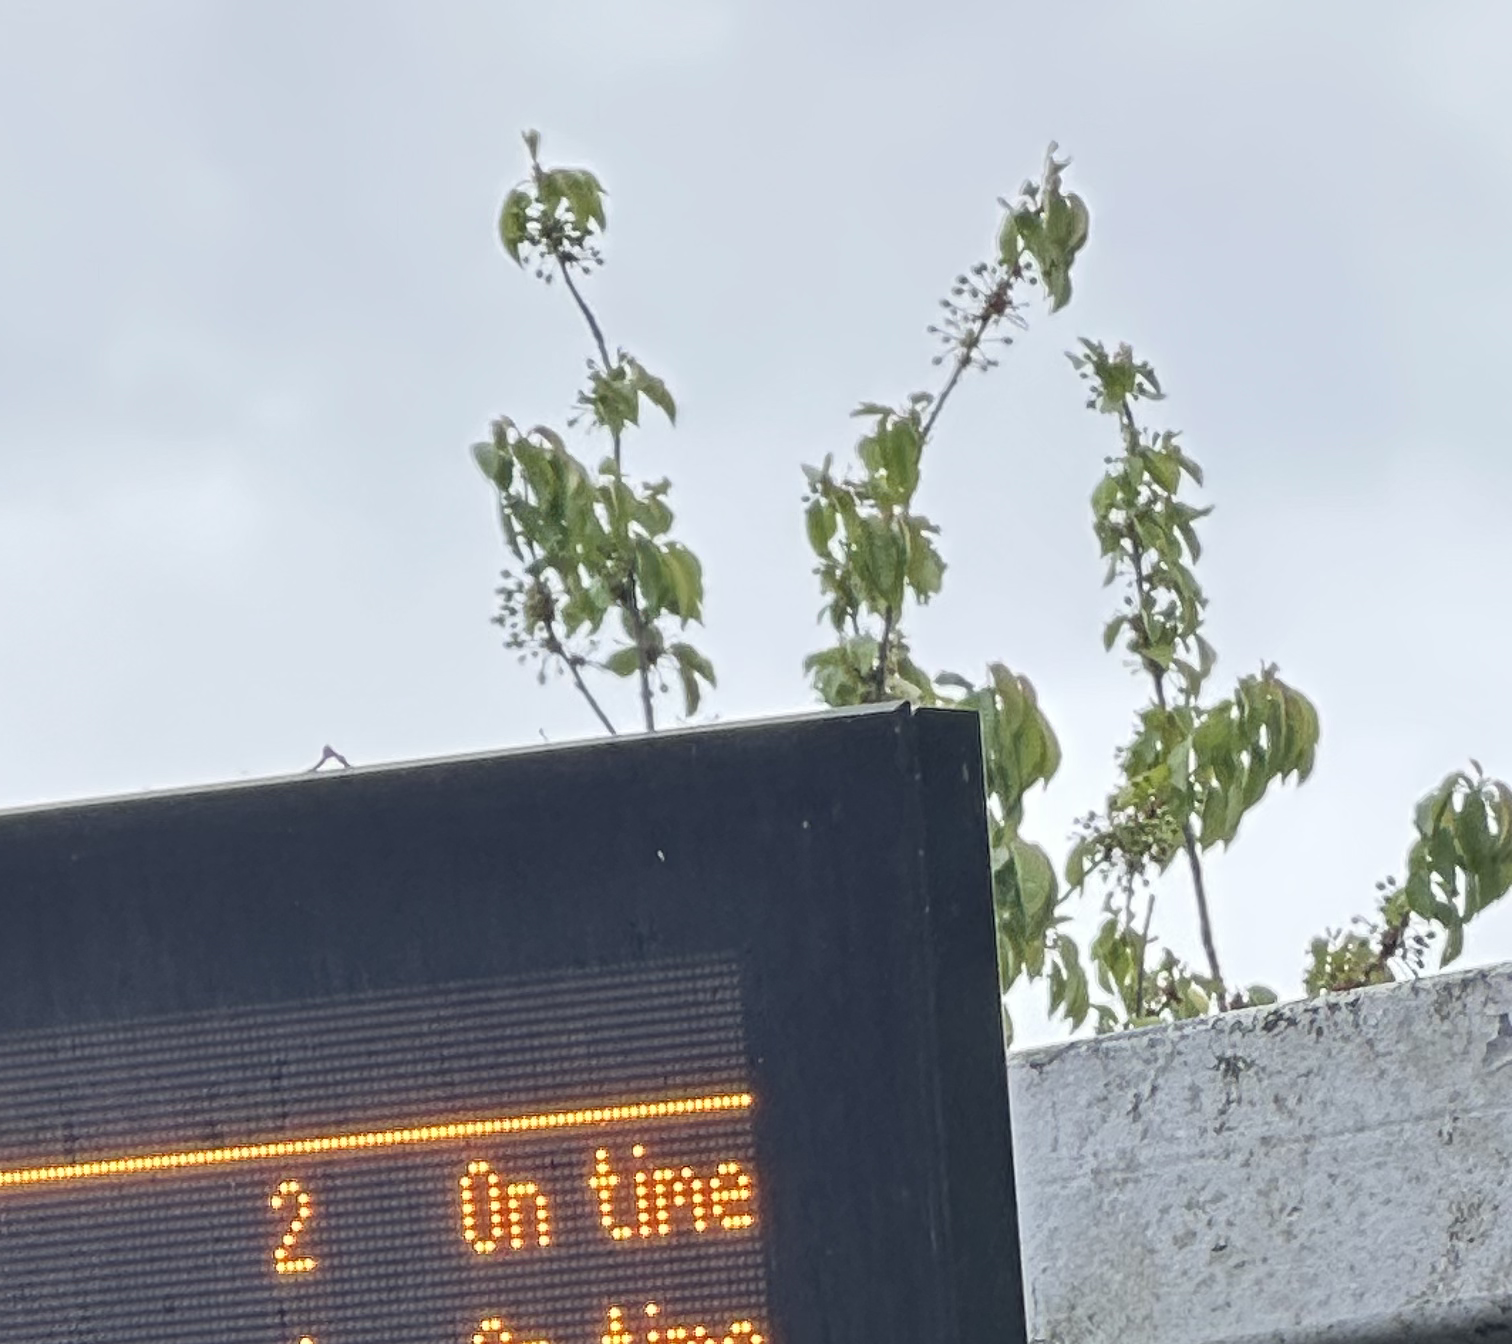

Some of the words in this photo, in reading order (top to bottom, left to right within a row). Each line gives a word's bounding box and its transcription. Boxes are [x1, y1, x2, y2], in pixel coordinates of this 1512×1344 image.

[269, 1178, 317, 1273] 2
[459, 1158, 552, 1253] On
[589, 1142, 755, 1240] time
